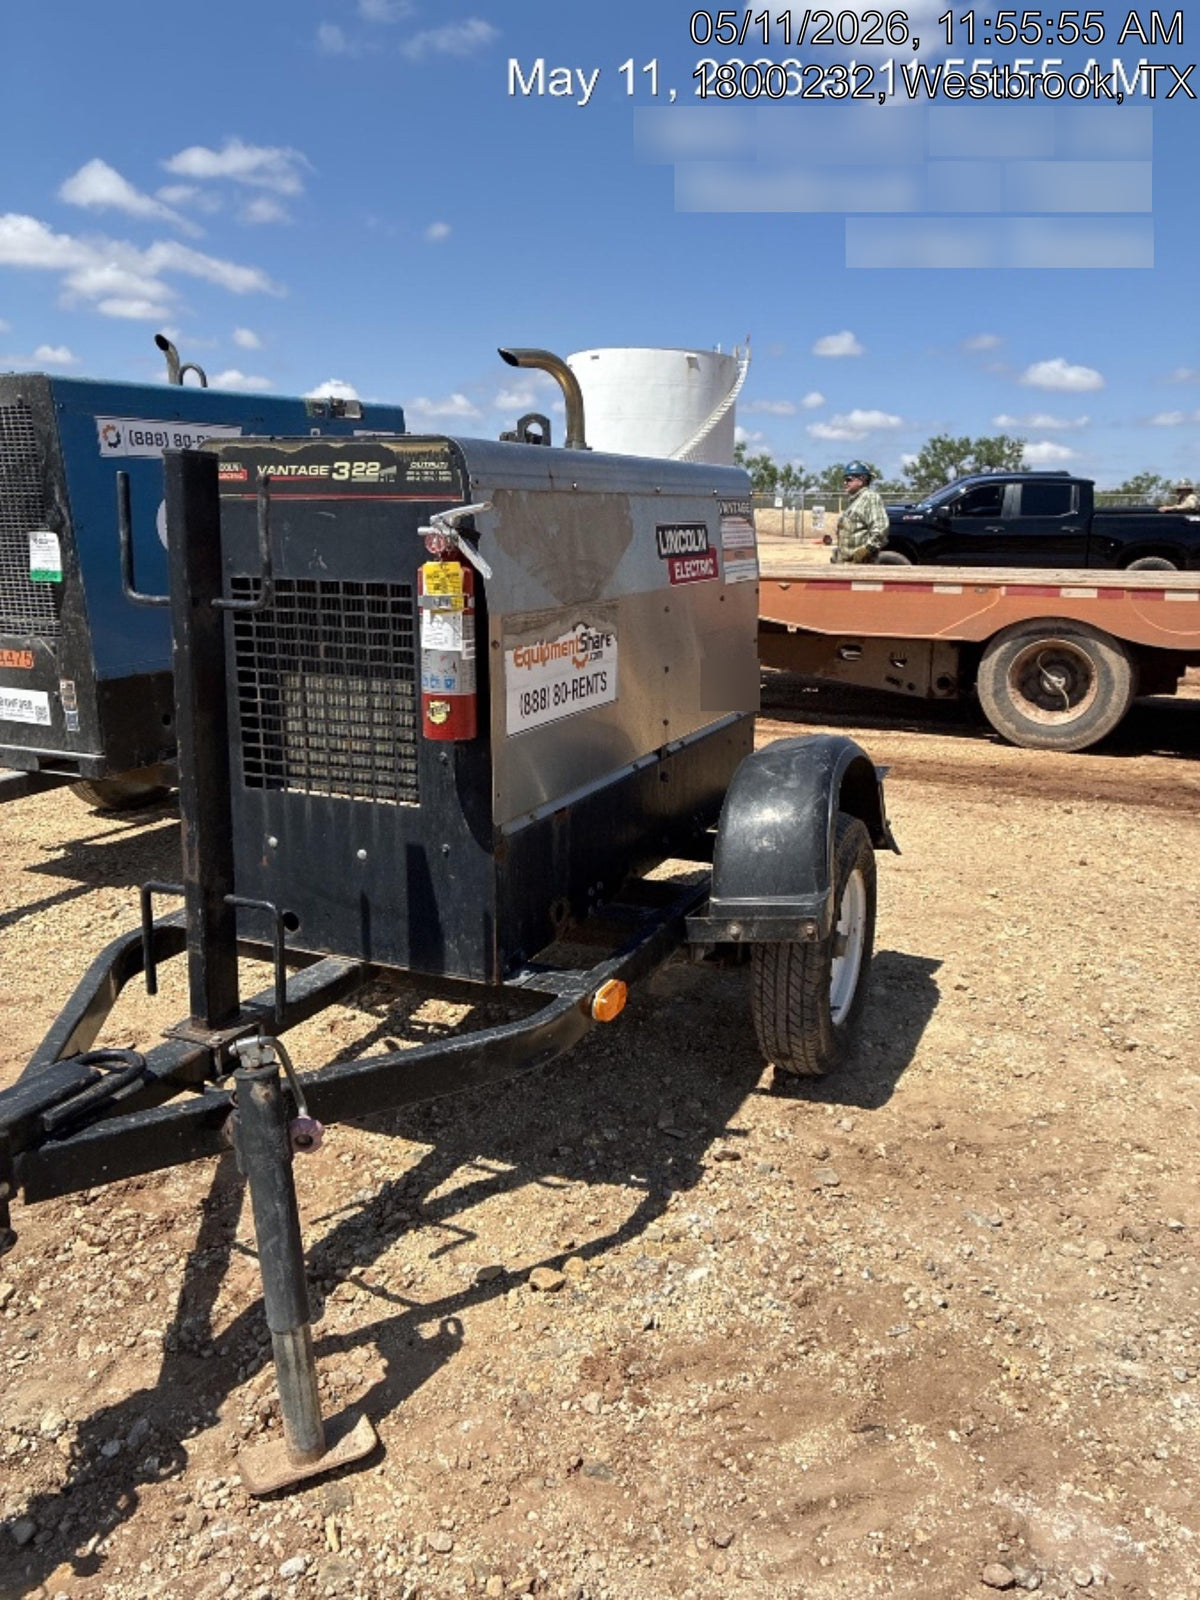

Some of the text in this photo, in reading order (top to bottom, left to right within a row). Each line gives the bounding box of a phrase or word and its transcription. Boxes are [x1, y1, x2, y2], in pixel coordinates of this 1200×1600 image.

[129, 429, 169, 448] (888)
[257, 464, 330, 476] VANTAGE
[332, 461, 380, 480] 322
[658, 528, 707, 556] LINCOLN
[674, 558, 714, 580] ELECTRIC
[513, 632, 612, 671] EquipmentShare
[520, 671, 608, 719] (888) 80-RENTS
